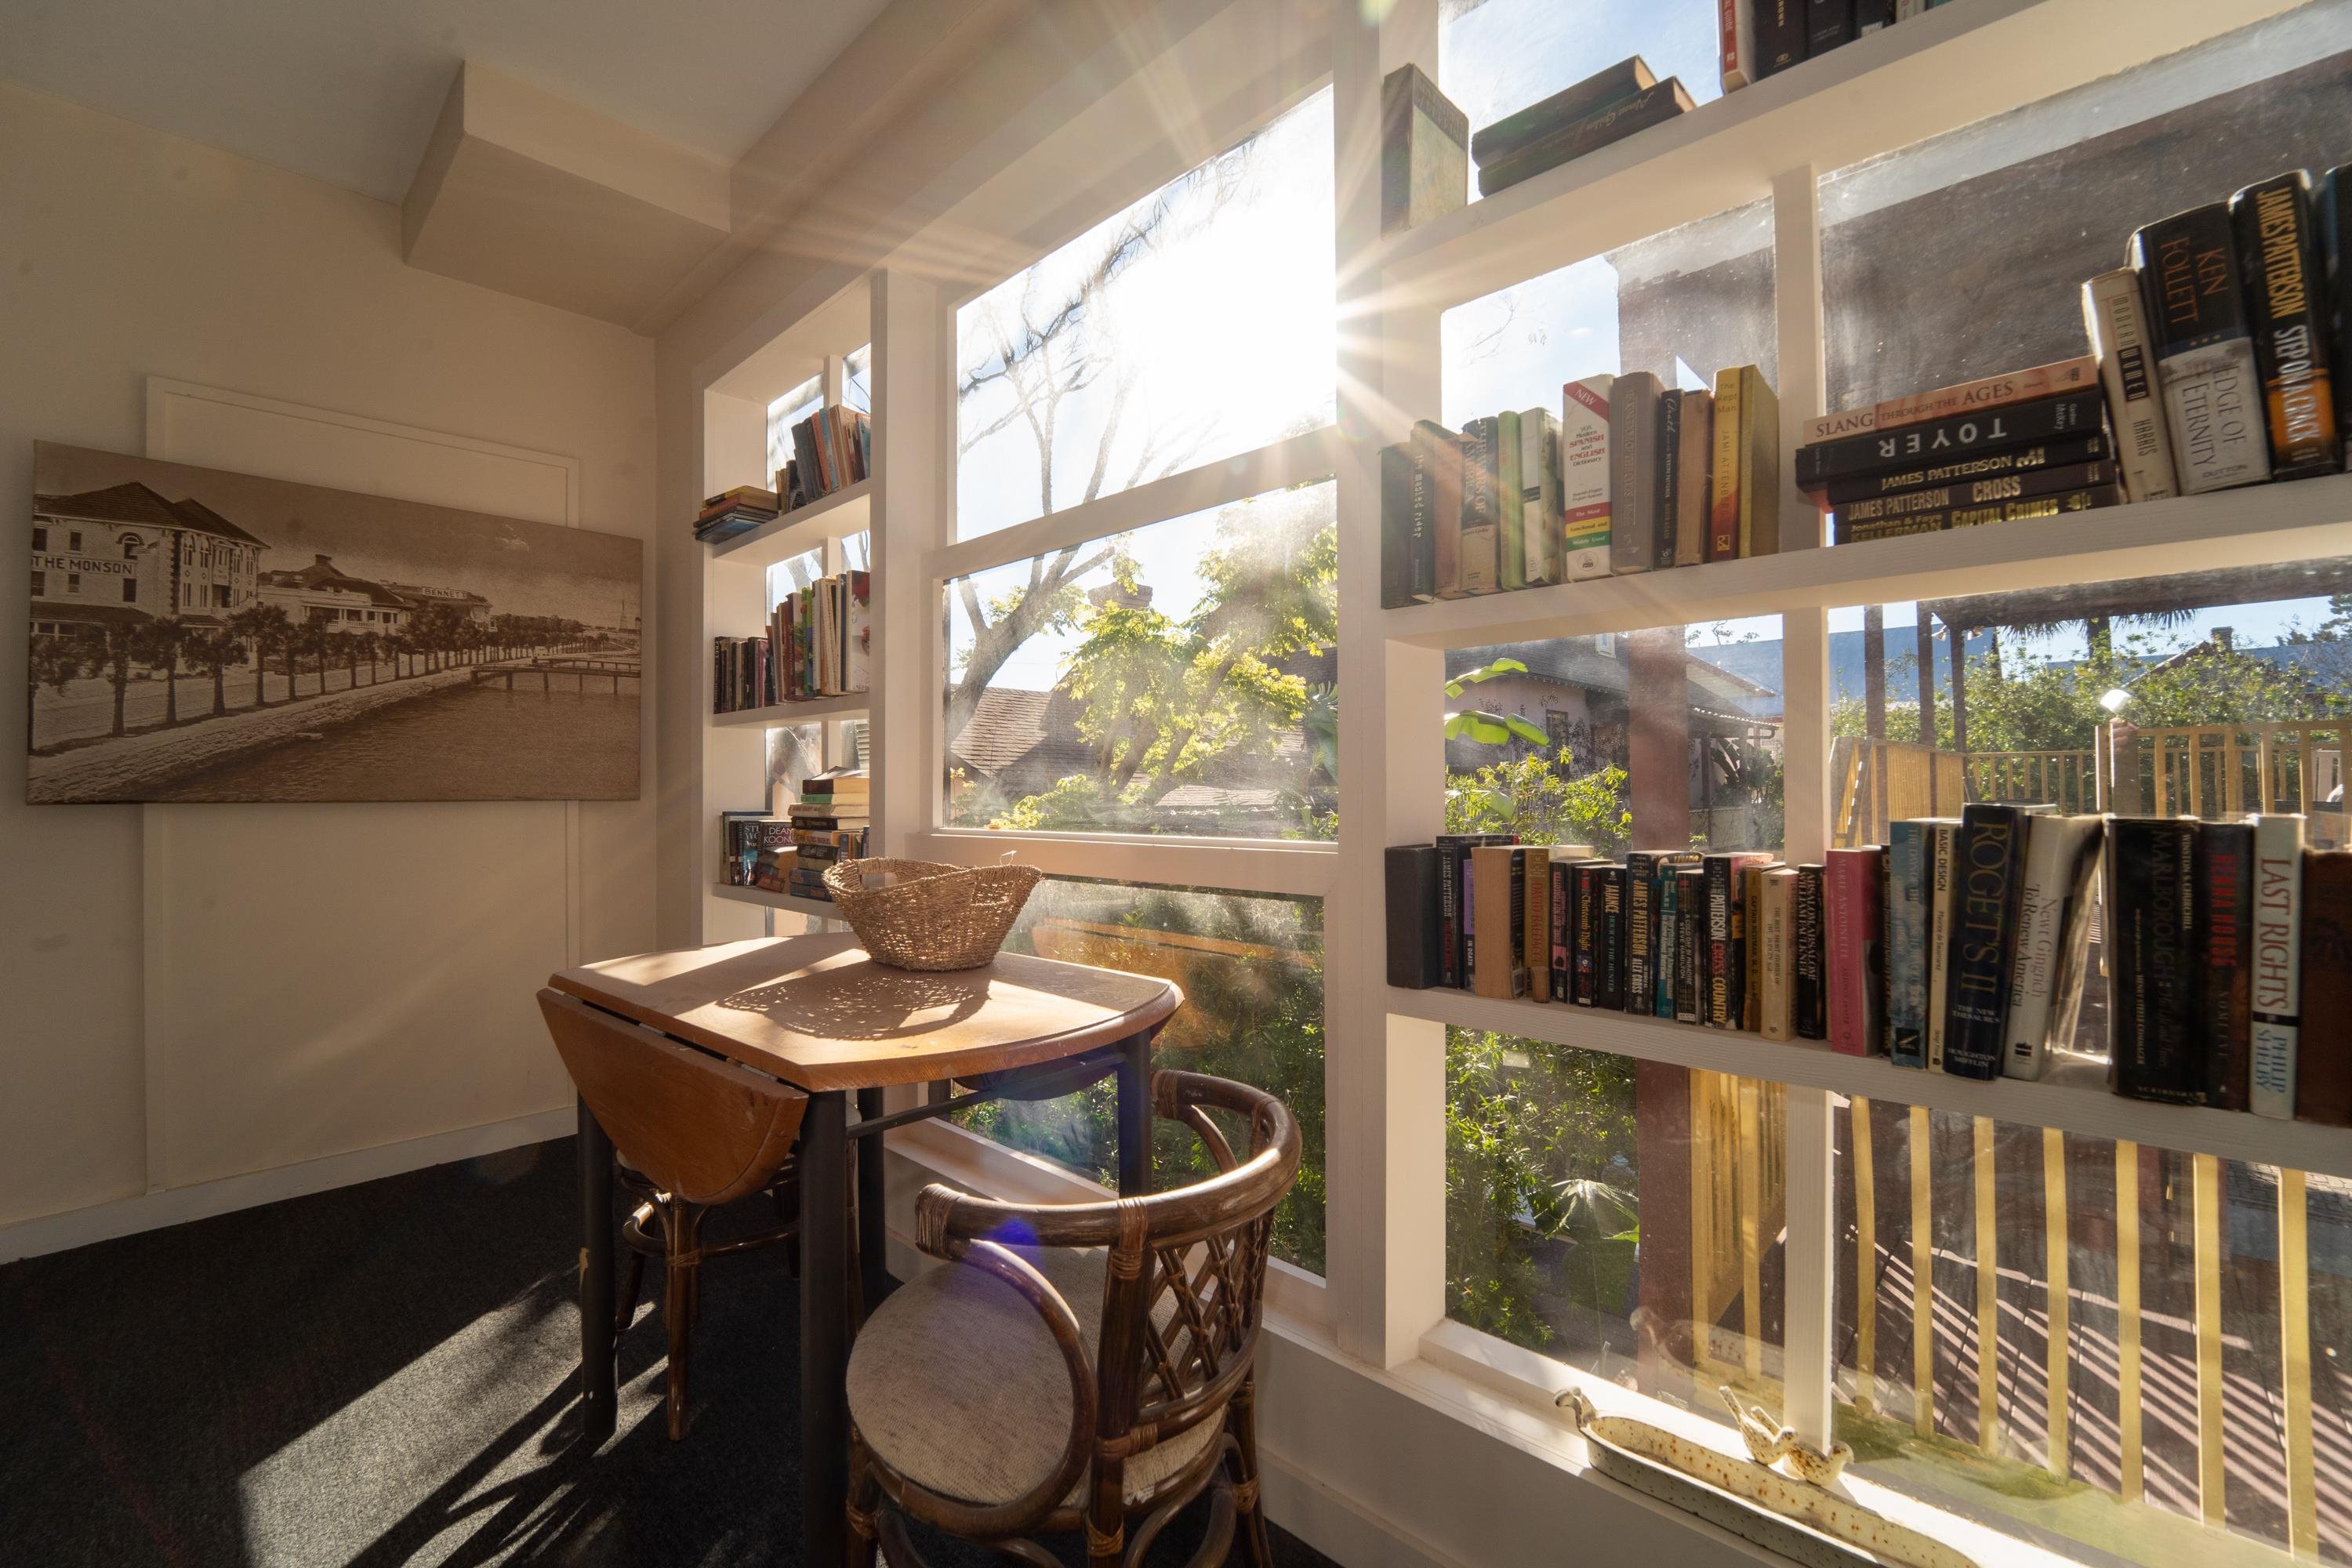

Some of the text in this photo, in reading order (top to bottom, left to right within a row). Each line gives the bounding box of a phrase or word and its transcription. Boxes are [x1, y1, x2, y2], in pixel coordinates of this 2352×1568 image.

[2195, 246, 2228, 296] KEN
[2256, 187, 2307, 319] JAMES PATTERSON
[2160, 237, 2198, 323] FOLLETT
[2111, 296, 2147, 401] MODERN WOMEN
[2274, 324, 2310, 360] STEP
[2278, 360, 2312, 385] ON
[1574, 388, 1598, 405] NEW
[1664, 398, 1675, 433] Death
[1717, 393, 1737, 401] Kept
[1816, 380, 2014, 438] SLANG THROUGH THE AGES
[2212, 365, 2247, 445] EDGE OF
[2283, 394, 2321, 444] CRACK
[1570, 434, 1604, 448] SPANISH
[1879, 417, 2007, 458] TOYER
[2132, 419, 2158, 456] HARRIS
[2182, 383, 2216, 466] ETERNITY
[1465, 443, 1475, 503] AMERICA
[1475, 424, 1486, 514] THE WARS OF
[1570, 448, 1606, 461] ENGLISH
[1573, 457, 1602, 466] Dictionary
[1882, 470, 1924, 491] JAMES
[1928, 455, 2013, 481] PATTERSON
[1413, 455, 1425, 538] the masked rider
[1721, 458, 1730, 516] ATTENBERG
[1848, 488, 1949, 521] JAMES PATTERSON
[1973, 475, 2022, 503] CROSS
[1850, 520, 1900, 533] Jonathan
[1916, 513, 1943, 524] Faye
[1951, 506, 2002, 528] CAPITAL
[2005, 498, 2060, 521] CRIMES
[32, 556, 132, 575] THE MONSON
[425, 589, 466, 598] BENNETT
[1907, 829, 1918, 847] THE
[1908, 849, 1918, 870] DAYS
[1936, 829, 1948, 891] BASIC DESIGN
[2182, 834, 2192, 873] WINSTON
[1443, 855, 1452, 917] JAMES PATTERSON
[1530, 882, 1543, 912] DAVID
[1908, 872, 1918, 884] OF
[1909, 887, 1919, 903] THE
[1580, 895, 1592, 951] Thirteenth Night
[1632, 880, 1648, 956] JAMES PATTERSON
[1710, 894, 1726, 940] PATTERSON
[1798, 872, 1808, 975] WILLIAM FAULKNER
[1806, 873, 1817, 980] ABSALOM, ABSALOM!
[1837, 858, 1849, 960] MARIE ANTOINETTE
[1910, 908, 1919, 945] FRENCH
[1959, 821, 2009, 995] ROGET'S II
[2182, 883, 2192, 931] CHURCHILL
[2209, 854, 2237, 967] HENNA HOUSE
[1530, 915, 1543, 962] BALDACCI
[1608, 937, 1615, 946] OF
[1667, 915, 1675, 946] Everything
[2013, 884, 2041, 1007] To Renew America
[2031, 898, 2058, 998] Newt Gingrich
[2258, 858, 2292, 1010] LAST RIGHTS
[1632, 958, 1642, 993] ALEX CROSS
[1711, 943, 1726, 1024] CROSS COUNTRY
[1947, 1047, 1996, 1061] HOUGHTON
[1954, 1056, 1988, 1066] MIFFLIN
[2255, 1029, 2271, 1091] SHELBY
[2270, 1036, 2288, 1094] PHILIP
